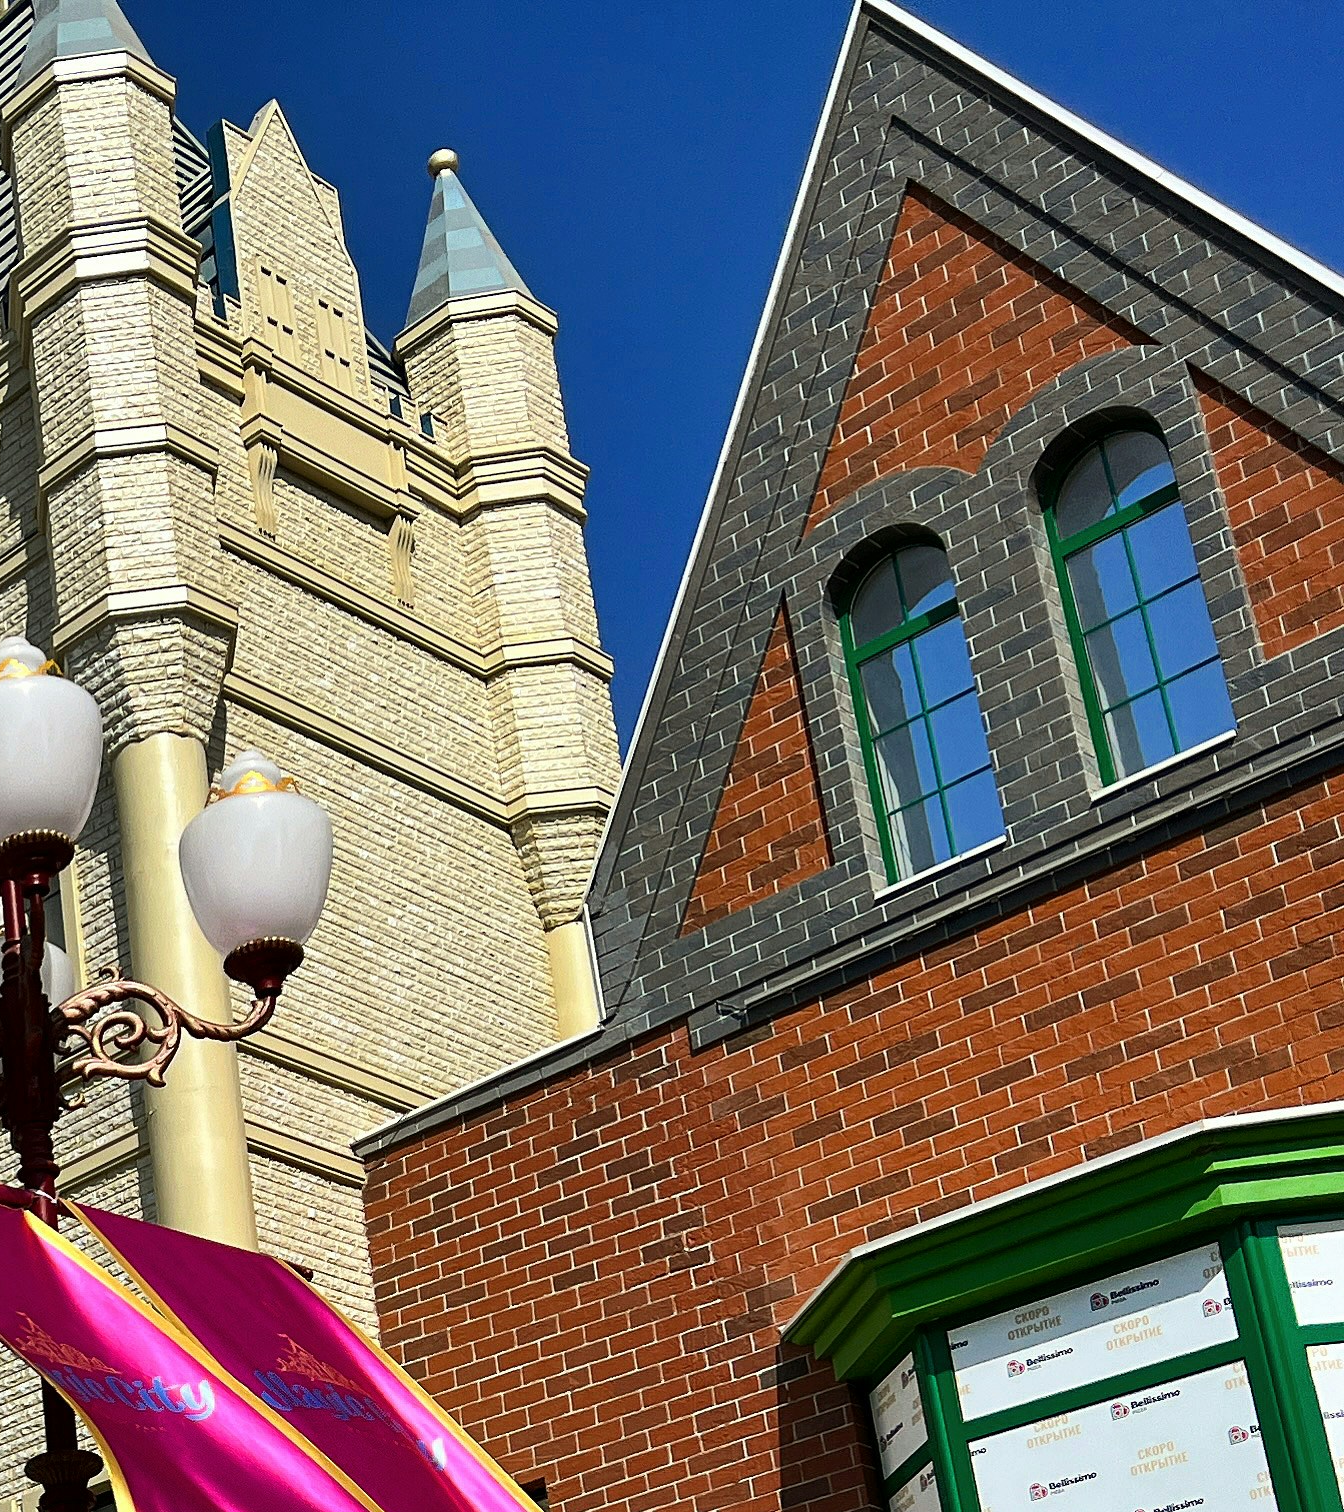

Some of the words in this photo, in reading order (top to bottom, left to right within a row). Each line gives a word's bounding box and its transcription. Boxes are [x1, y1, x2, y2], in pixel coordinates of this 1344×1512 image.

[1109, 1277, 1160, 1300] Bellissimo
[1014, 1305, 1050, 1325] СКОРО
[1113, 1315, 1150, 1334] СКОРО
[1007, 1315, 1062, 1341] ОТКРЫТИЕ
[1105, 1325, 1163, 1351] ОТКРЫТИЕ
[1025, 1346, 1074, 1366] Bellissimo
[106, 1375, 216, 1422] City
[1130, 1388, 1181, 1409] Bellissimo
[1026, 1424, 1082, 1449] ОТКРЫТИЕ
[1137, 1441, 1175, 1461] СКОРО
[1130, 1451, 1189, 1477] ОТКРЫТИЕ
[1048, 1471, 1098, 1491] Bellissimo
